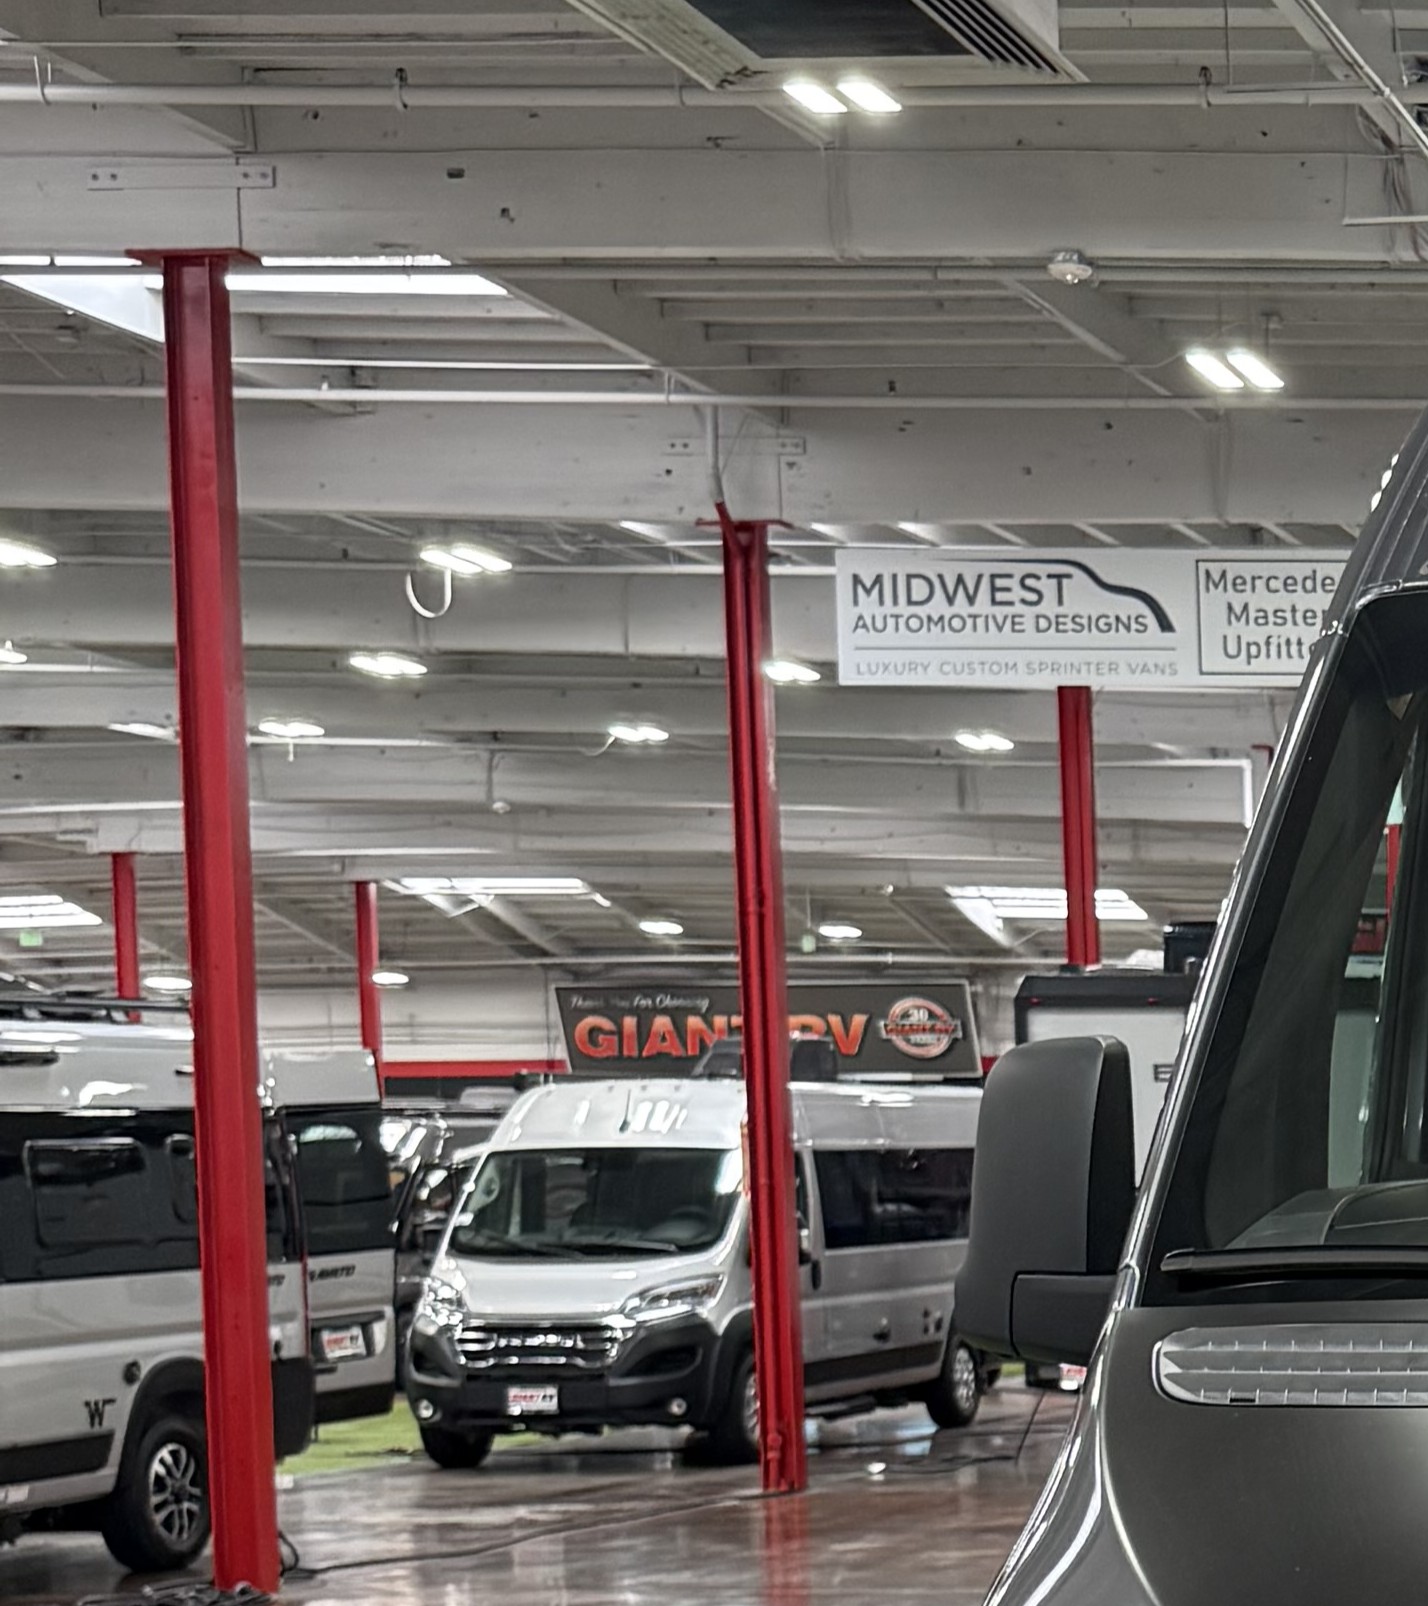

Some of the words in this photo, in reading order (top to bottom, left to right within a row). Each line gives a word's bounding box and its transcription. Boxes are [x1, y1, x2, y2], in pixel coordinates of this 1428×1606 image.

[851, 572, 1073, 608] MIDWEST
[1204, 568, 1336, 594] Mercede
[851, 613, 1026, 635] AUTOMOTIVE
[1034, 613, 1149, 635] DESIGNS
[1222, 634, 1315, 666] Upfitt
[856, 660, 932, 677] LUXURY
[938, 660, 1019, 677] CUSTOM
[1025, 660, 1120, 677] SPRINTER
[1127, 660, 1179, 677] VANS
[573, 1014, 743, 1059] GIAN
